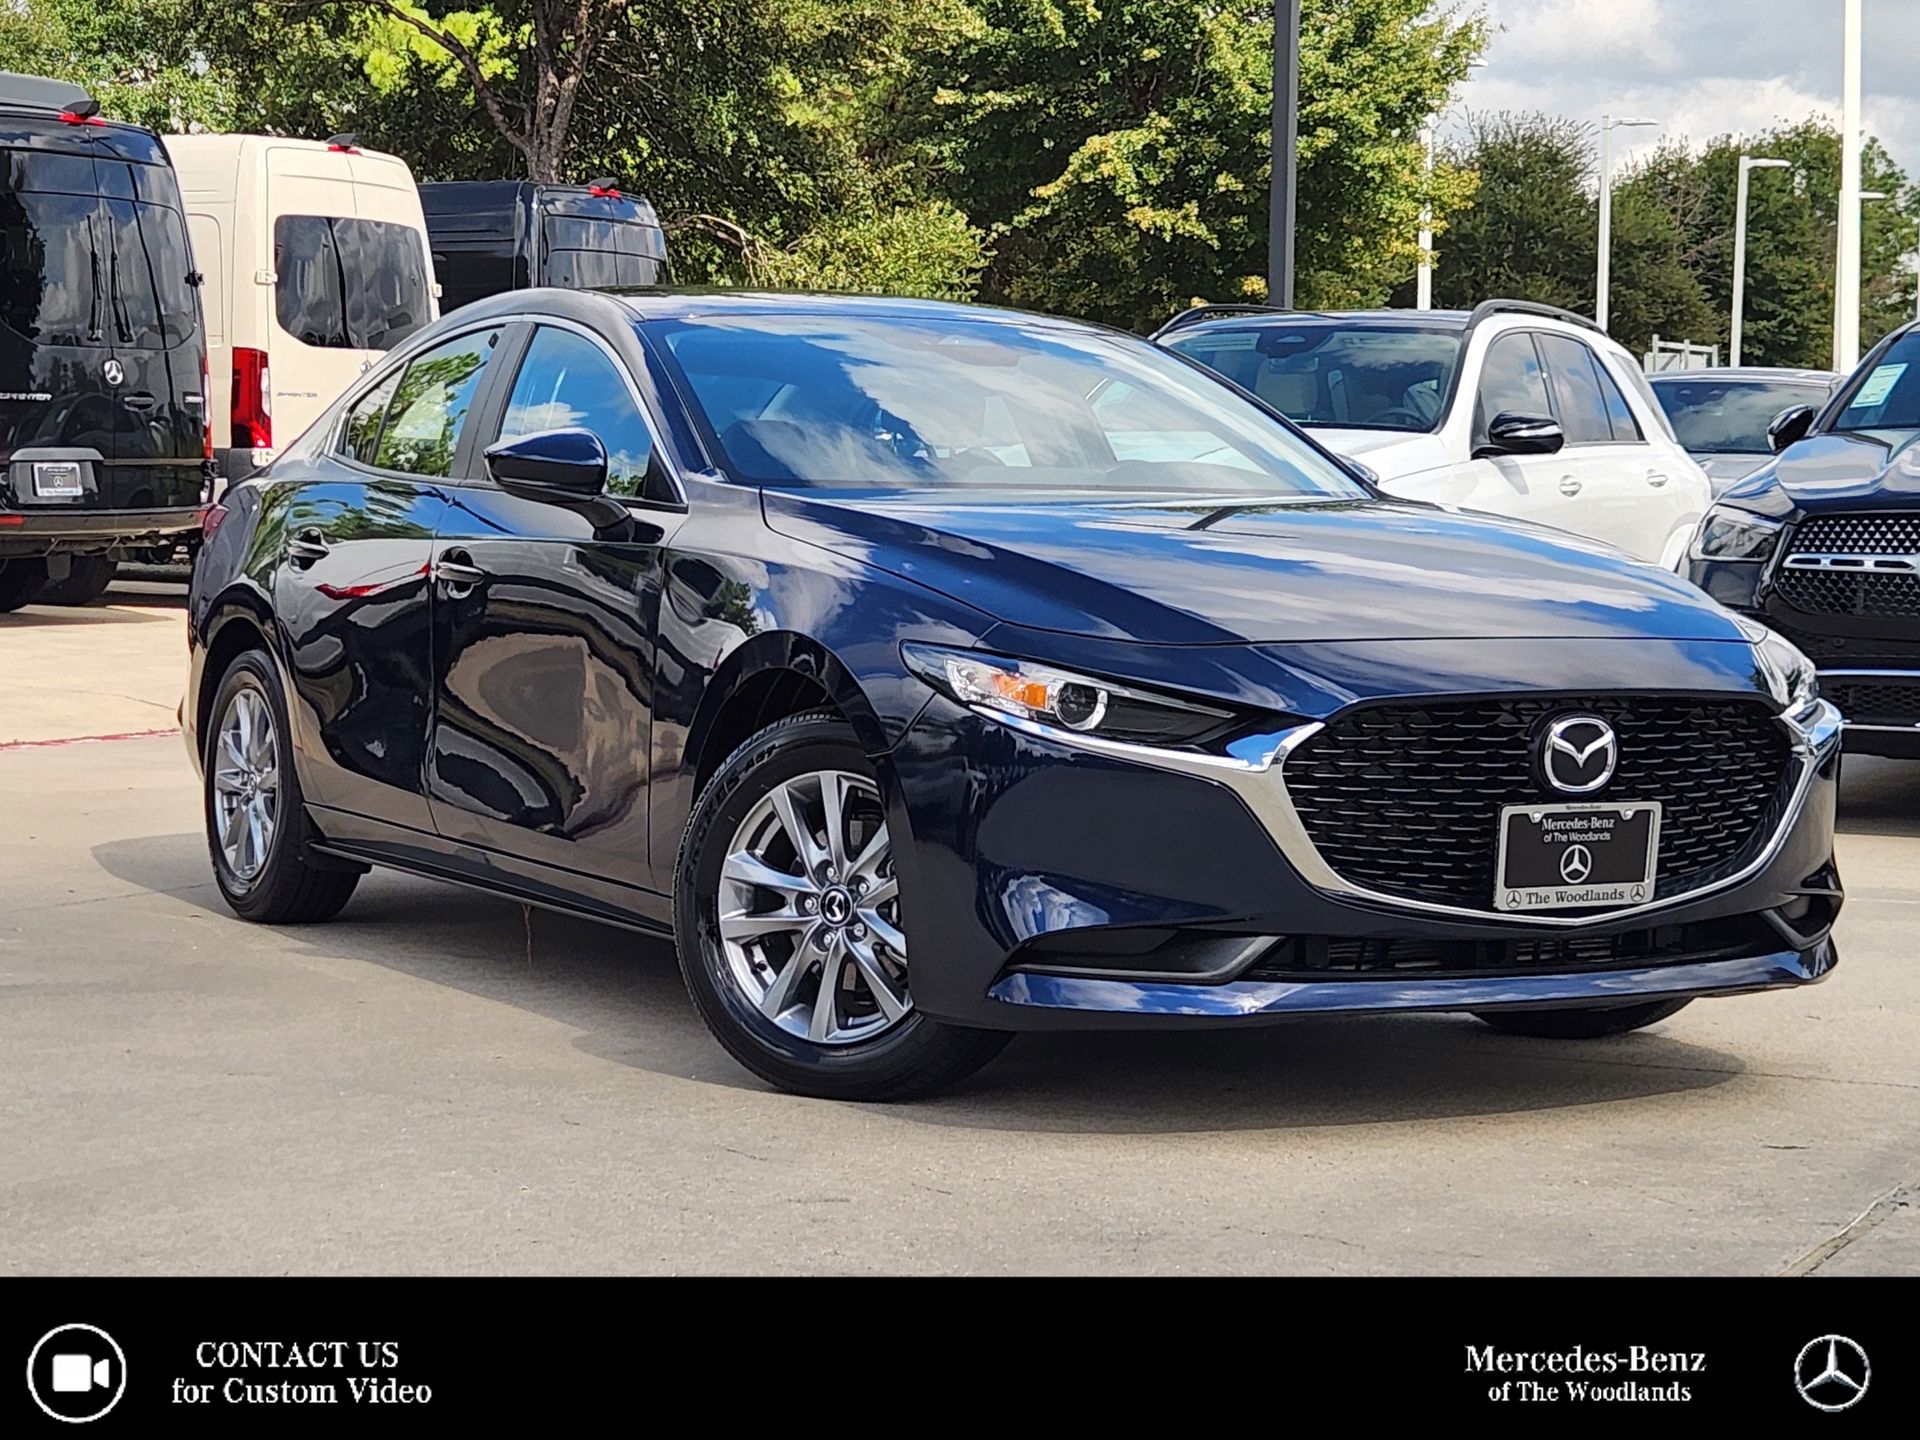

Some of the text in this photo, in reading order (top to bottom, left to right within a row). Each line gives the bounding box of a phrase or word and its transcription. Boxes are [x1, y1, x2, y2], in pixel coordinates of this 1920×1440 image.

[1541, 816, 1616, 831] Mercedes-Benz
[1543, 831, 1612, 843] of The Woodlands
[1525, 888, 1625, 905] The Woodlands
